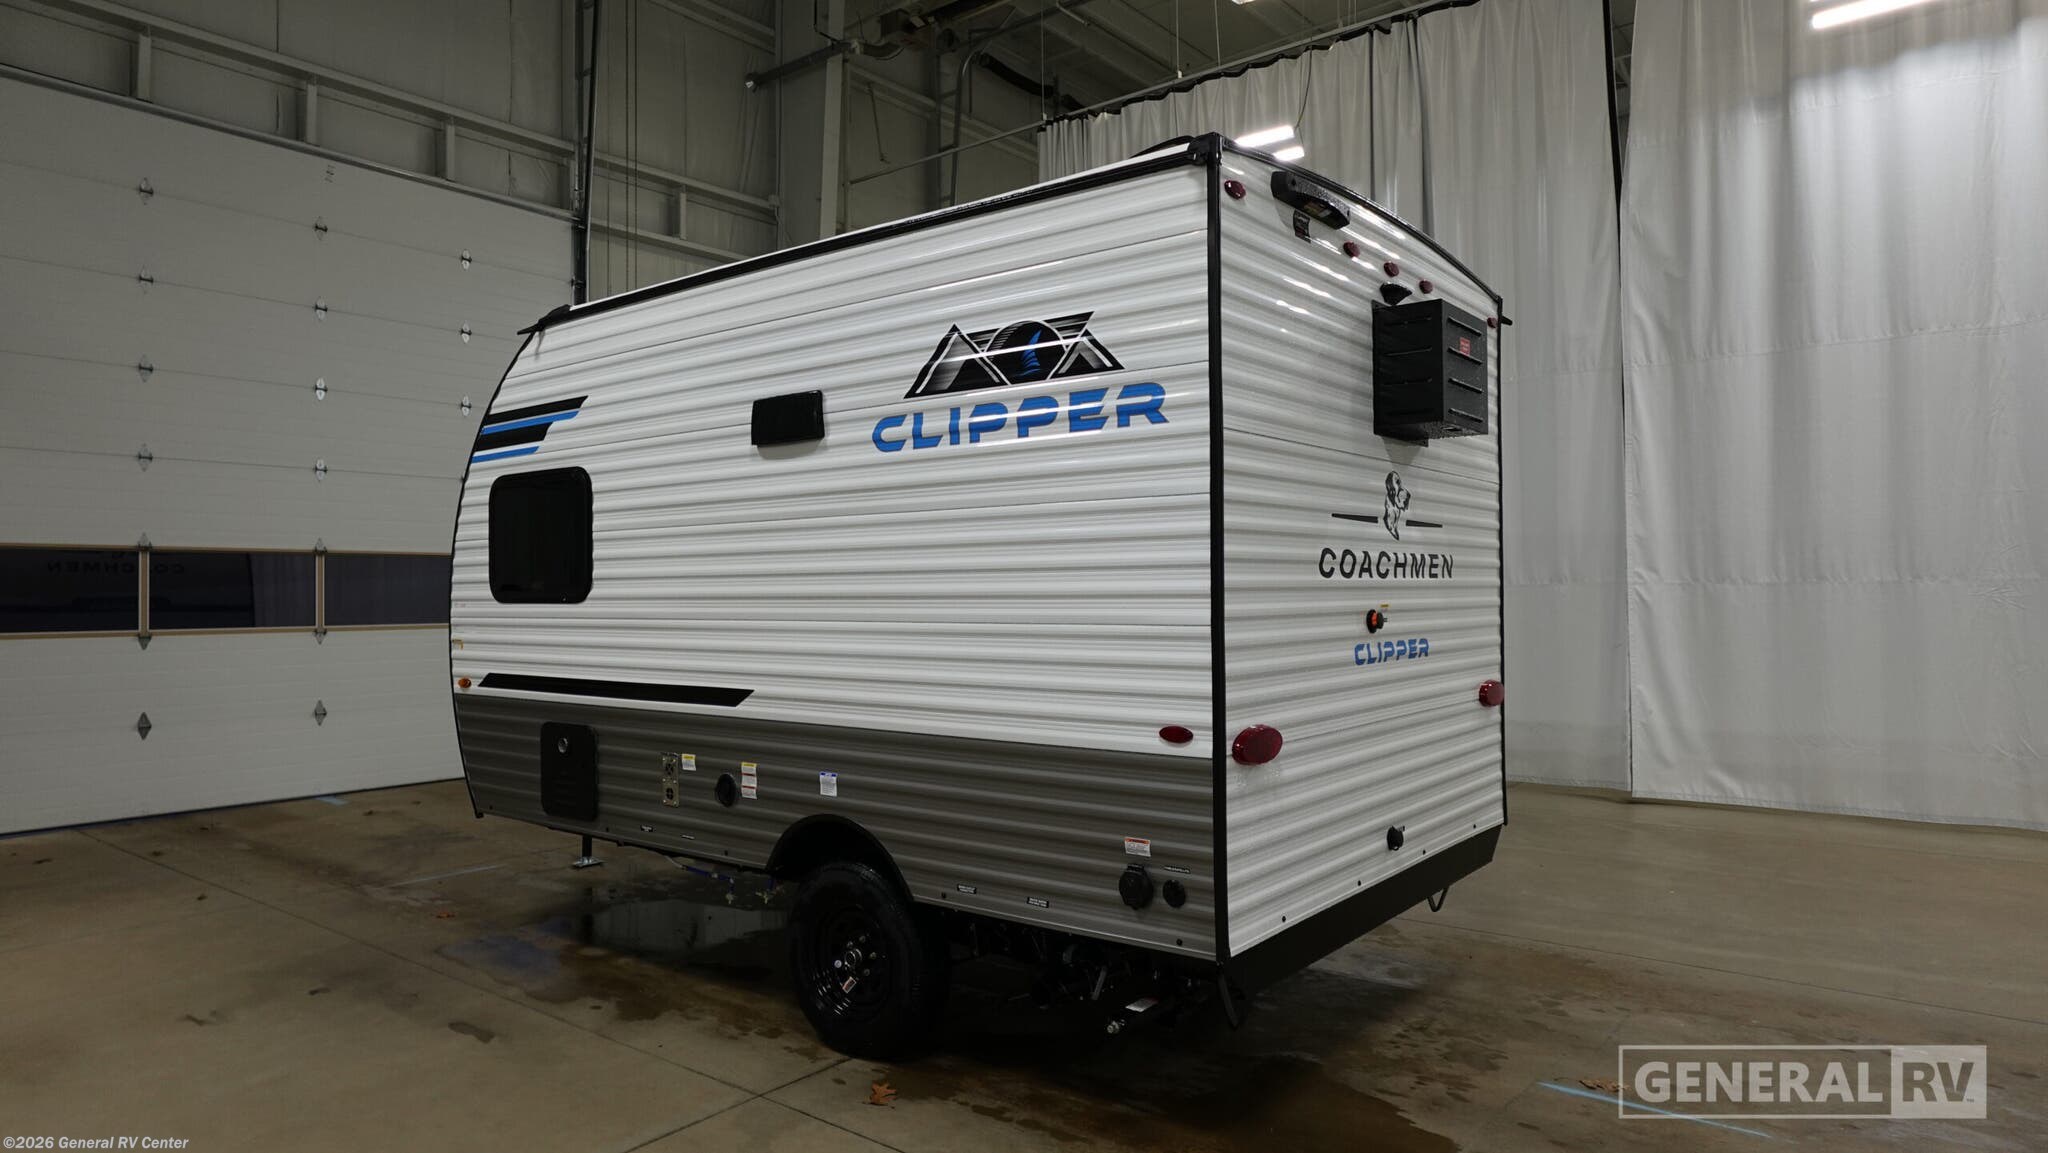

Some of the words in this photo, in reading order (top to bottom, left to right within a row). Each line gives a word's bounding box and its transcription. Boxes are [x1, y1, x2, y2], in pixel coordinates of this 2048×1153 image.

[872, 382, 1169, 452] CLIPPER
[1318, 547, 1454, 579] COACHMEN
[1354, 638, 1430, 666] CLIPPER
